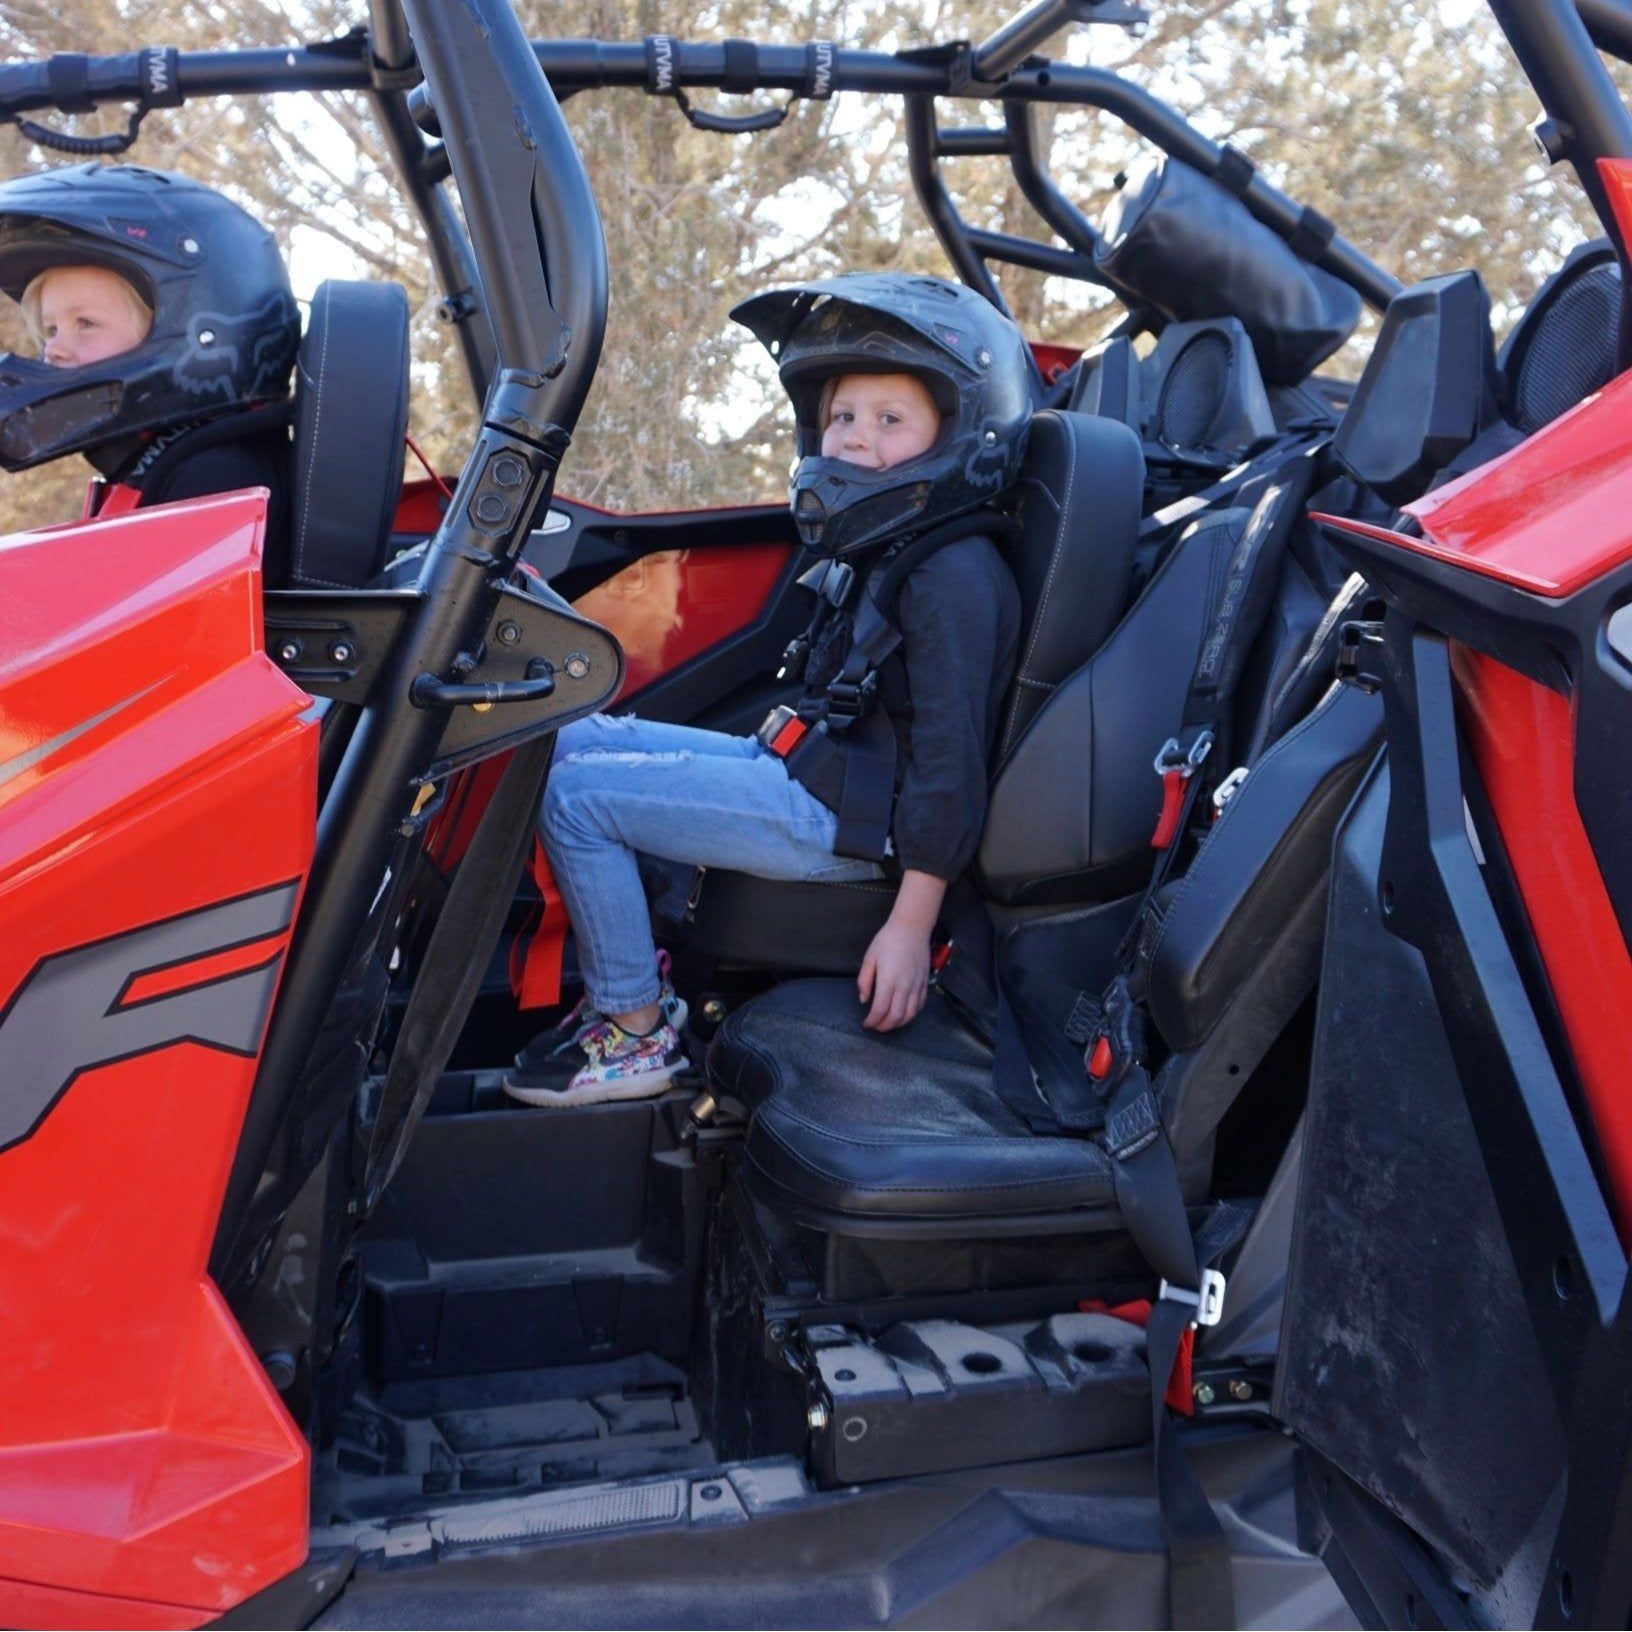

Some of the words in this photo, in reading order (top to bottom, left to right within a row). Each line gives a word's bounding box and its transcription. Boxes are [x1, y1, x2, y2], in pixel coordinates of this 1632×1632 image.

[149, 46, 168, 94] TVMA
[654, 37, 672, 90] UTVMA
[813, 44, 832, 95] UTVMA
